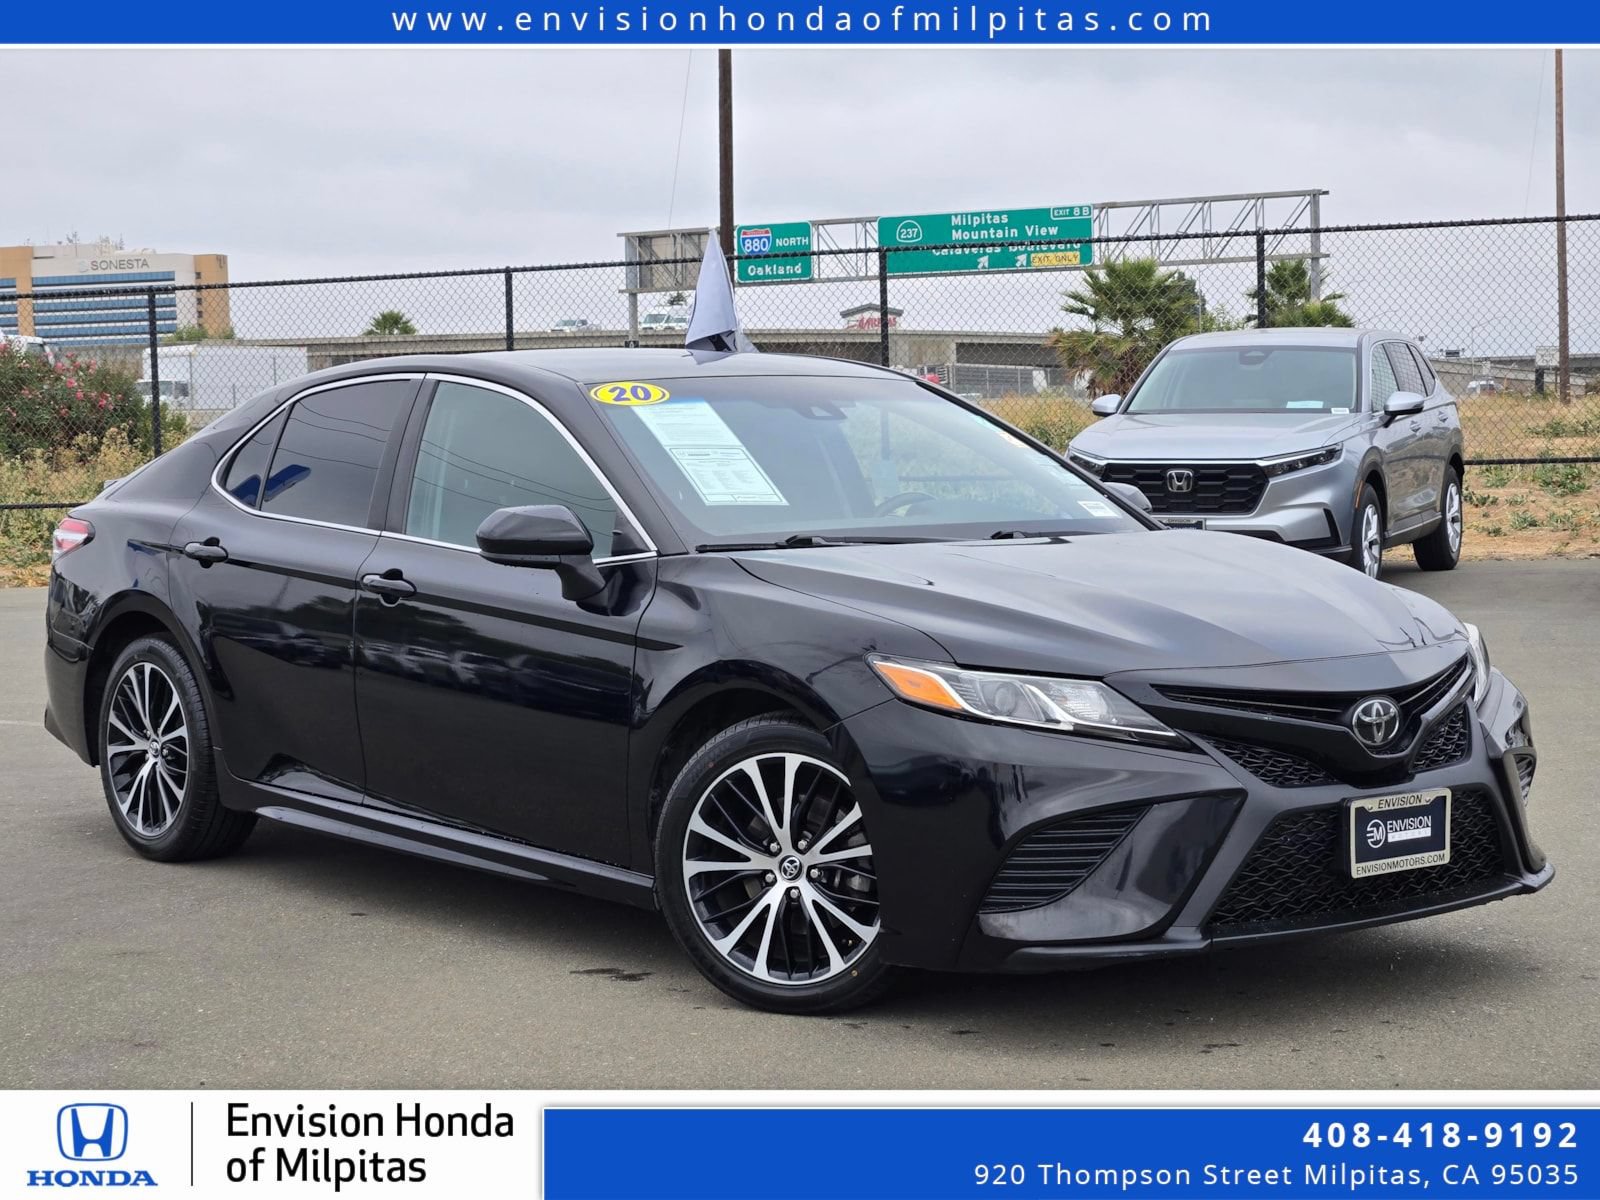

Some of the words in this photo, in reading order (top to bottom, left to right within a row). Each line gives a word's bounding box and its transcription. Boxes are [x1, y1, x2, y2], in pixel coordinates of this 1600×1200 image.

[1054, 208, 1070, 216] EXIT
[951, 213, 1008, 226] Milpitas
[900, 227, 918, 239] 237
[951, 227, 1018, 241] Mountain
[1025, 225, 1058, 237] View
[744, 237, 769, 253] 880
[775, 237, 809, 247] NORTH
[91, 257, 150, 271] SONESTA
[1032, 255, 1050, 264] EXIT
[1055, 253, 1079, 263] ONLY
[747, 262, 802, 276] Oakland
[608, 385, 652, 402] 20
[1377, 794, 1423, 810] ENVISION
[1387, 815, 1432, 833] ENVISION
[1356, 852, 1445, 876] ENVISIONMOTORS.COM
